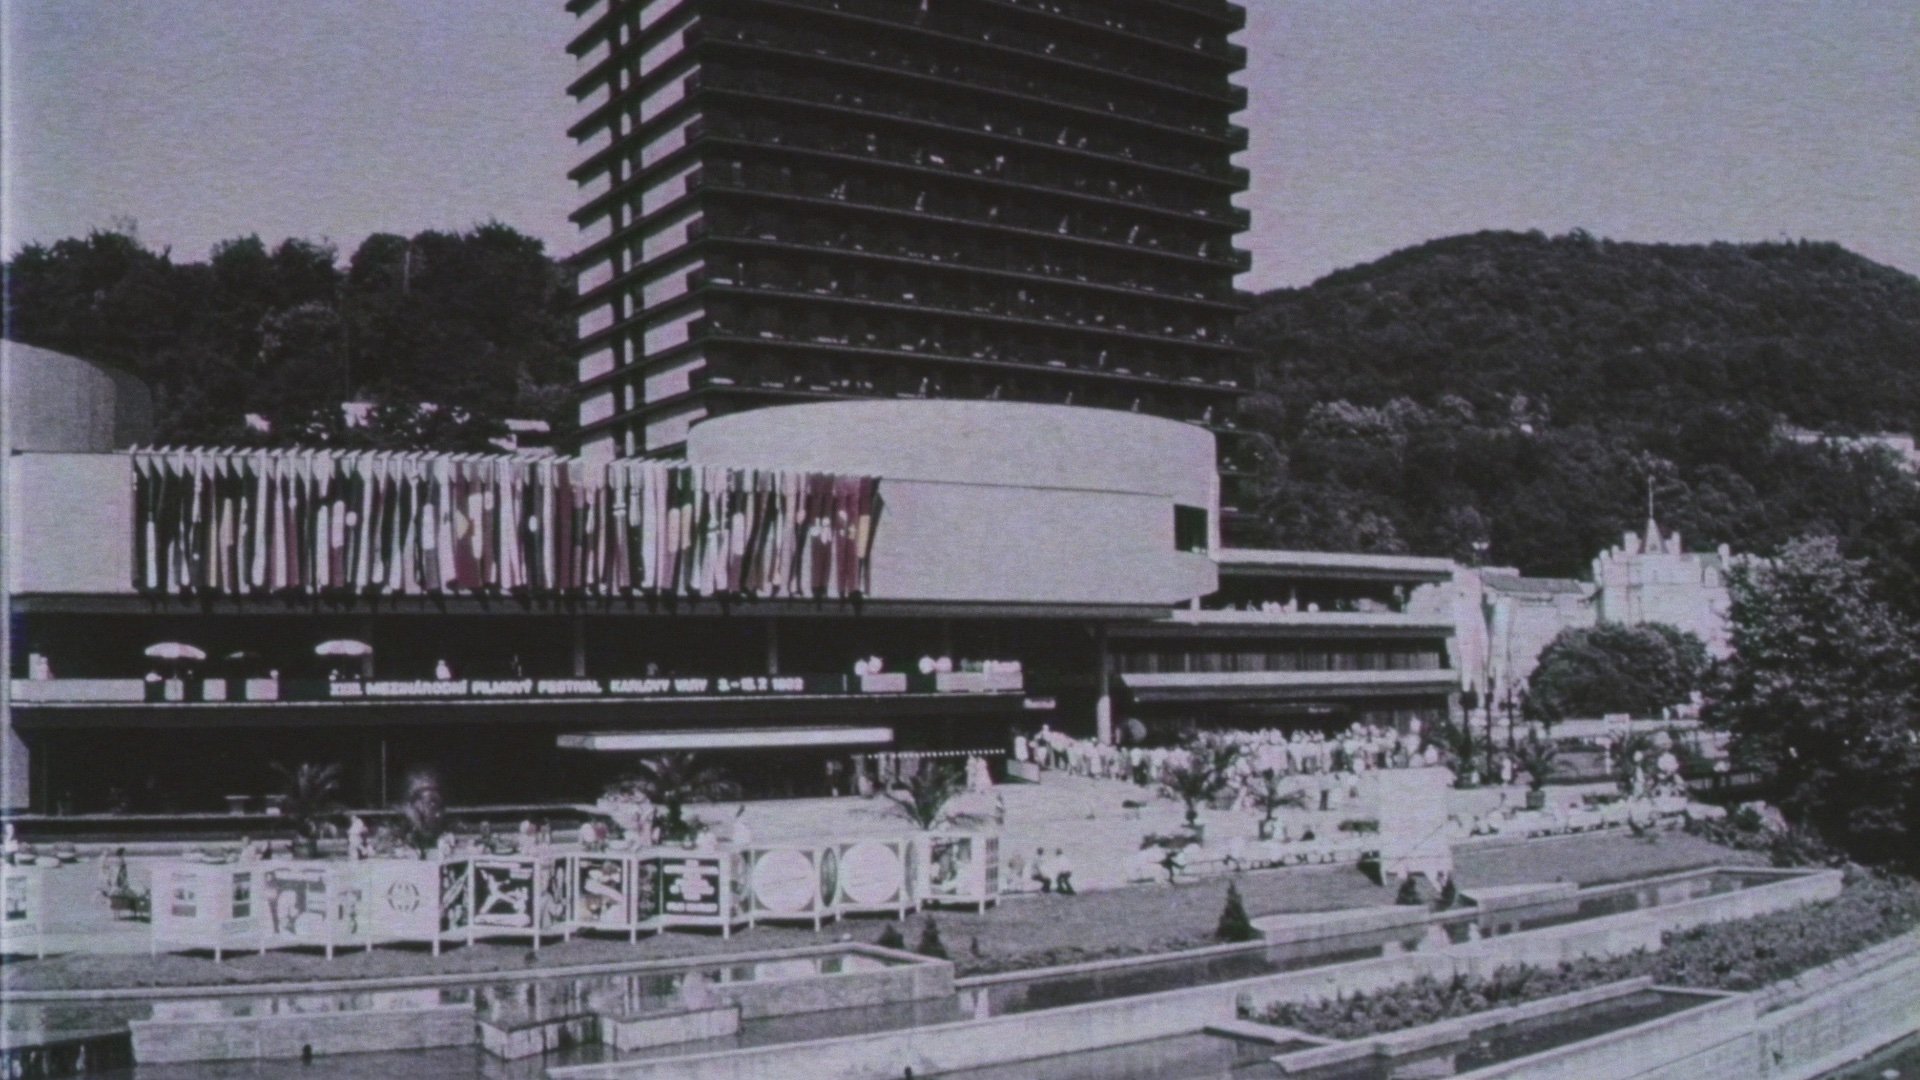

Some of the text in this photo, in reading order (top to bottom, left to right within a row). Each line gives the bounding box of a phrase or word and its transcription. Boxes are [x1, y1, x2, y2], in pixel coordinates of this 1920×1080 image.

[537, 679, 603, 695] FESTIVAL
[609, 678, 671, 694] KARLOVY
[674, 678, 708, 693] VARY
